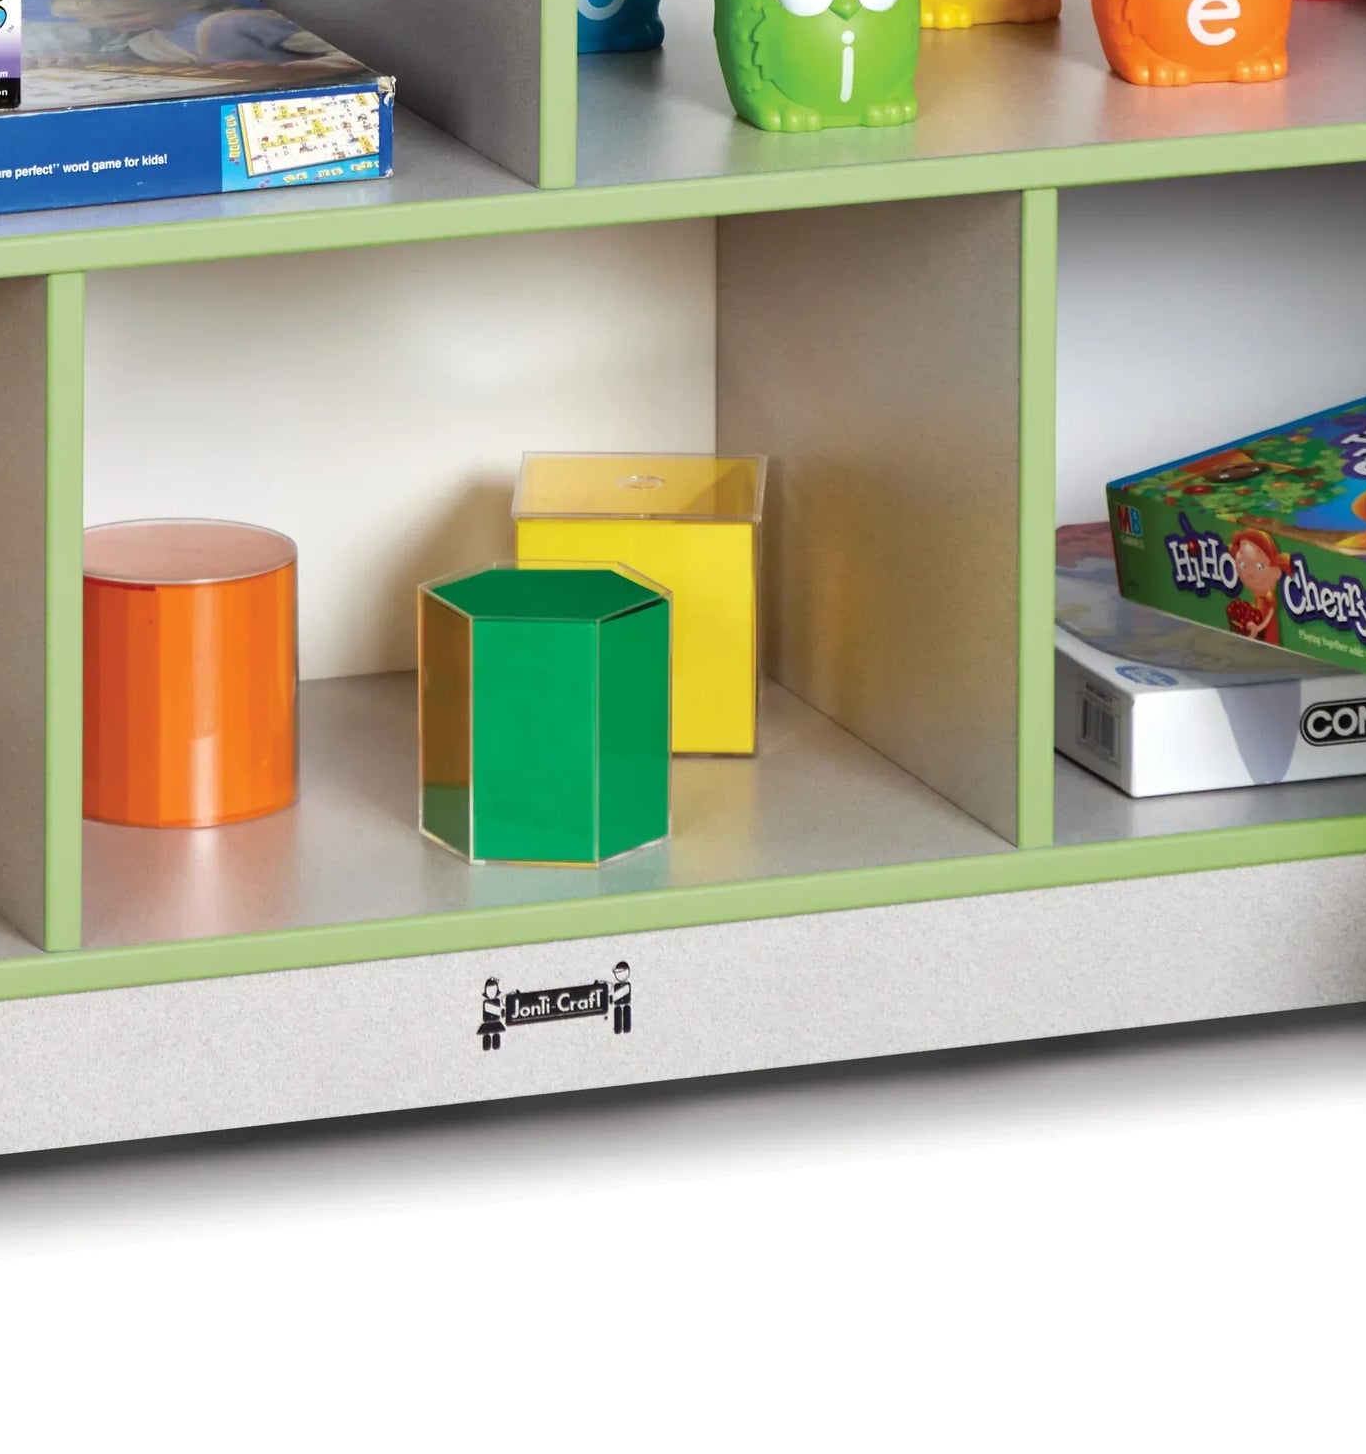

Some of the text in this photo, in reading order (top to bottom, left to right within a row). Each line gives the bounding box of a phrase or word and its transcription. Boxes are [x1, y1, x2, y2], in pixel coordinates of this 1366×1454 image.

[840, 30, 855, 103] i
[63, 161, 89, 173] word
[92, 160, 122, 173] game
[124, 156, 140, 168] for
[142, 153, 168, 166] kids!
[1298, 629, 1321, 646] Playing
[1322, 636, 1348, 652] together
[1349, 646, 1364, 657] adds
